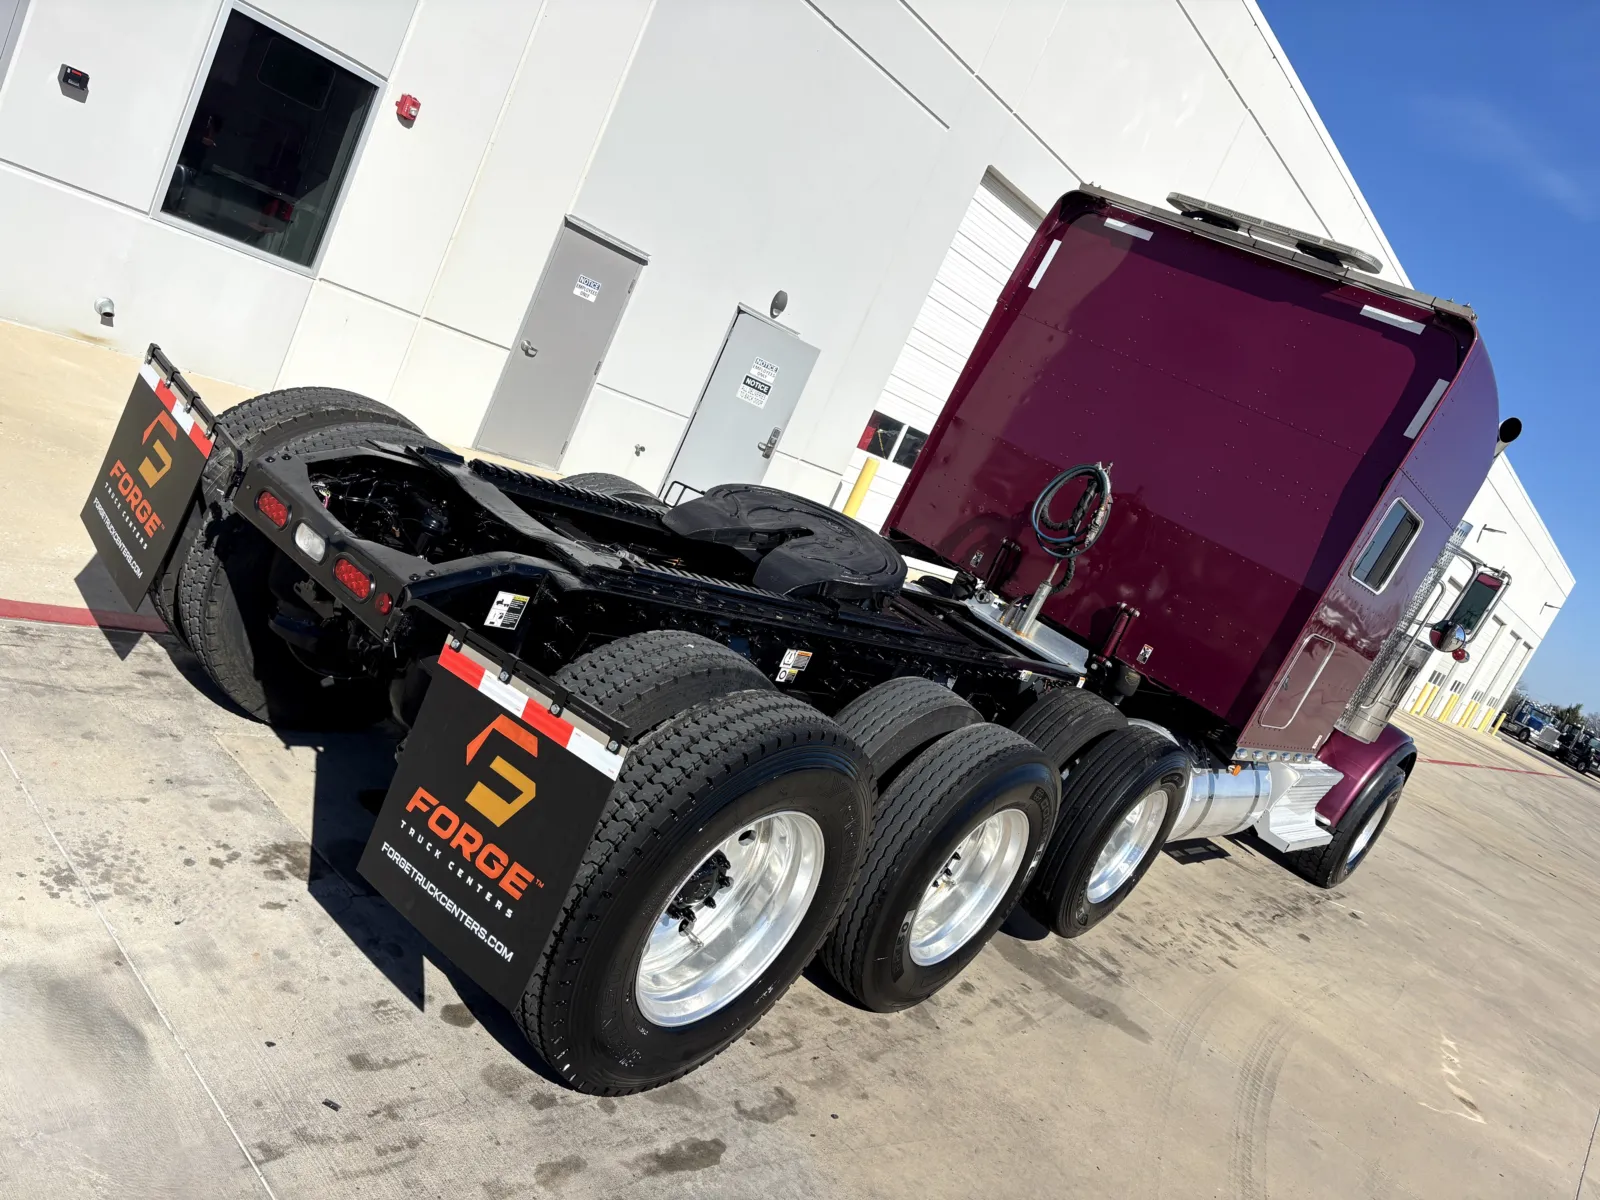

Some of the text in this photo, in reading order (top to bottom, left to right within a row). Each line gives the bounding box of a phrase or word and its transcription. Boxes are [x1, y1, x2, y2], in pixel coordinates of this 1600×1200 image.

[576, 283, 598, 296] EMPLOYEES
[579, 276, 600, 290] NOTICE
[745, 377, 769, 393] NOTICE
[752, 364, 776, 377] EMPLOYEES
[755, 358, 778, 373] NOTICE
[104, 482, 148, 550] TRUCK CENTERS
[109, 459, 162, 539] FORGE
[92, 496, 143, 579] FORGETRUCKCENTERS.COM
[399, 819, 513, 919] TRUCK CENTERS
[405, 786, 535, 901] FORGE
[381, 841, 514, 963] FORGETRUCKCENTERS.COM
